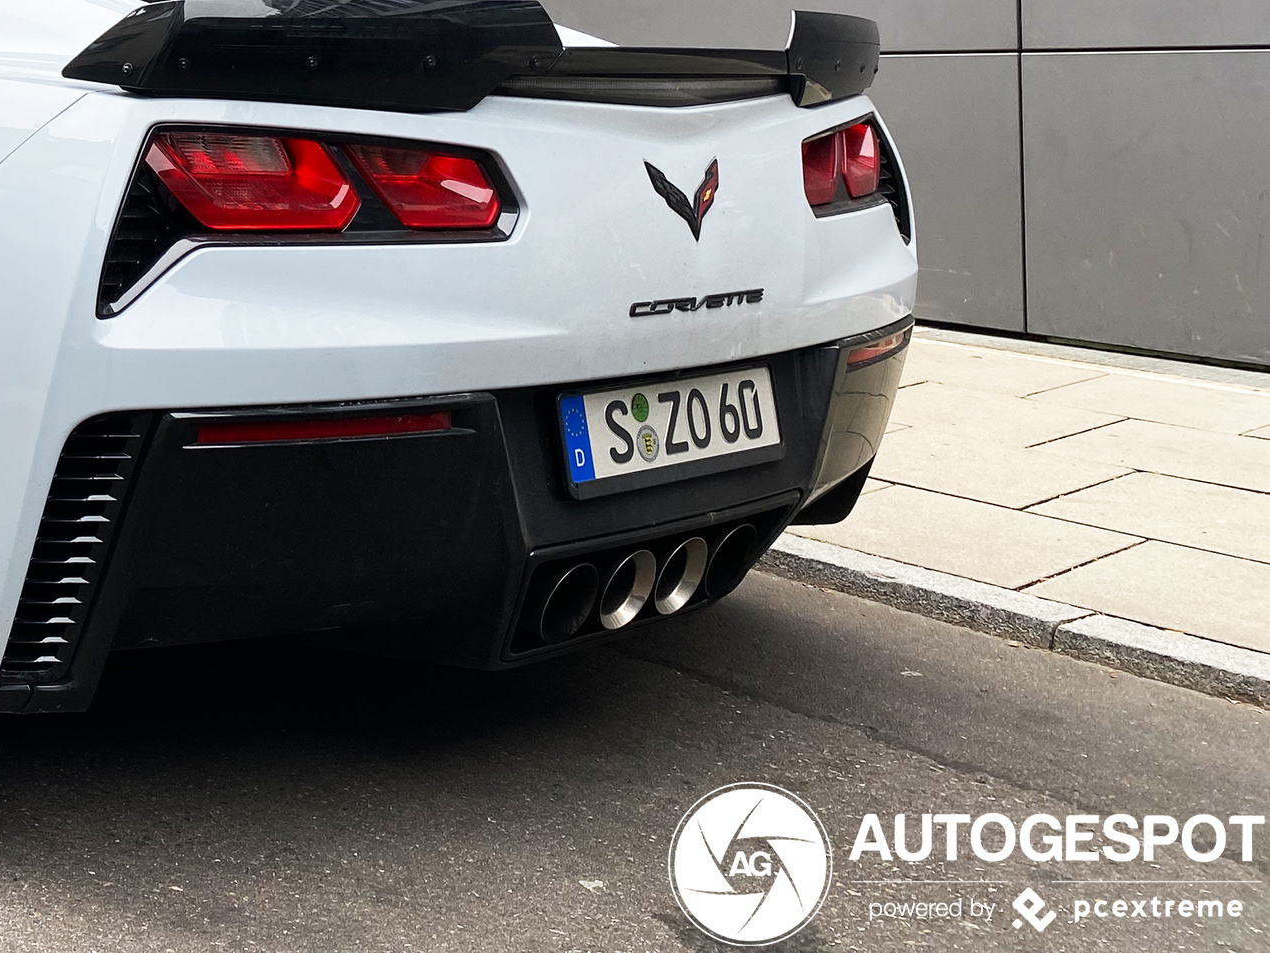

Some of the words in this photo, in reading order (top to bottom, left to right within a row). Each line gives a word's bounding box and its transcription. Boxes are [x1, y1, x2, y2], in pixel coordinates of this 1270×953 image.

[629, 288, 764, 318] CORVETTE
[605, 399, 634, 465] S
[719, 379, 764, 444] 60
[575, 448, 586, 467] D
